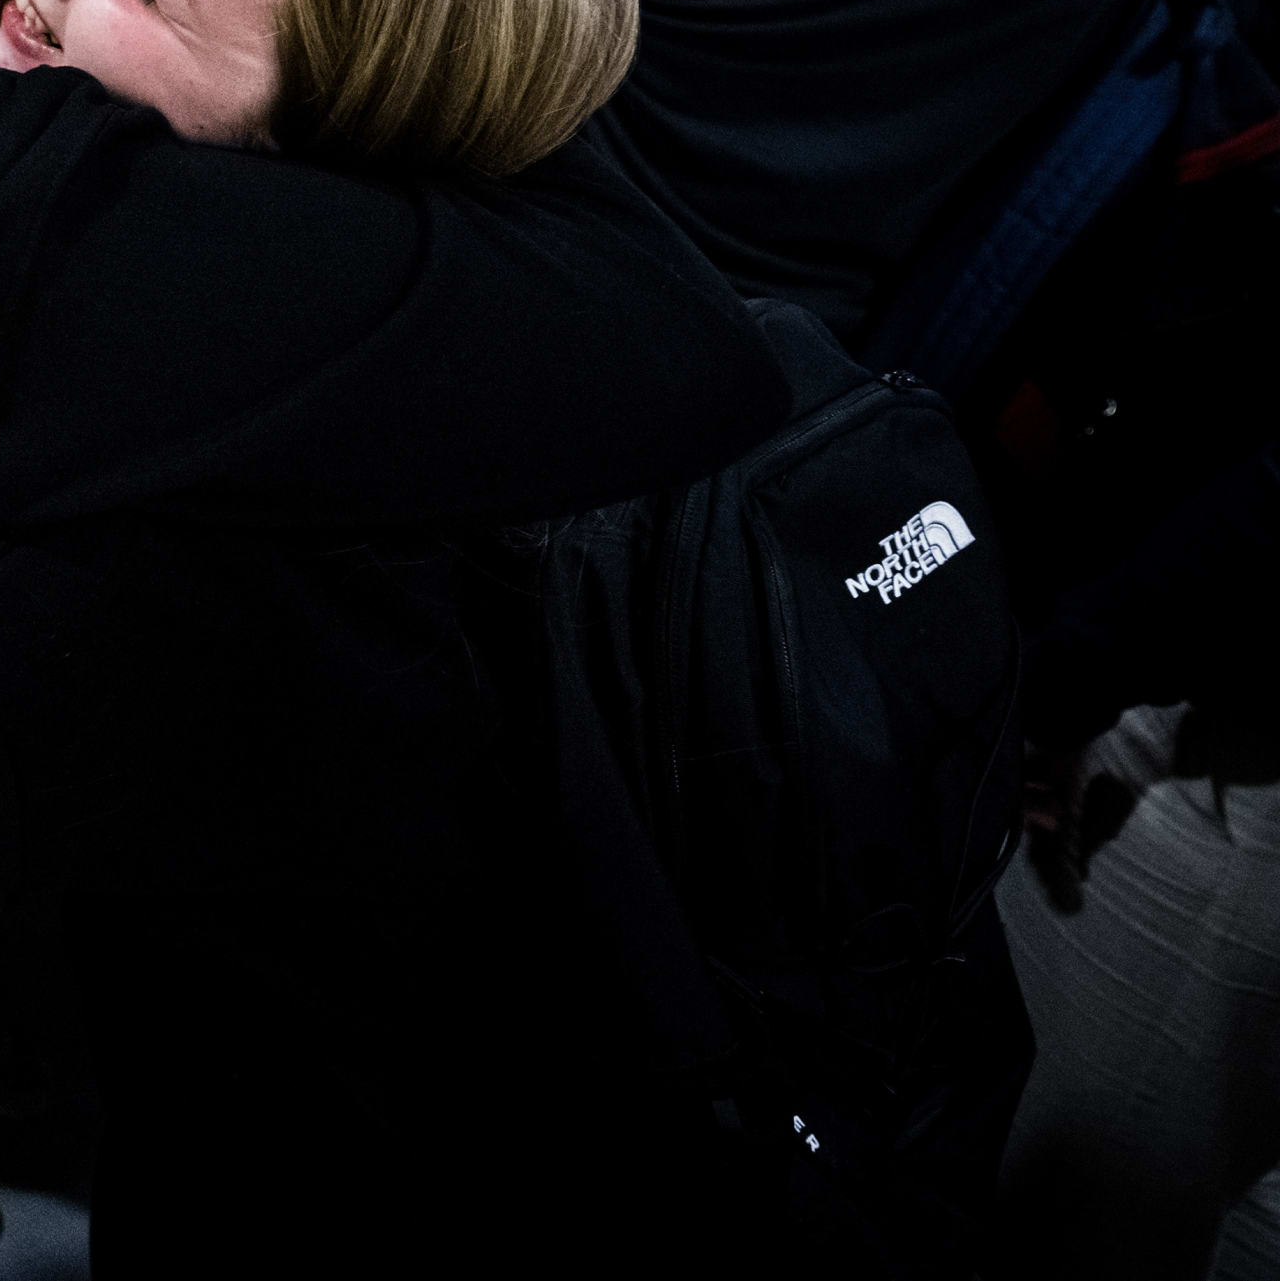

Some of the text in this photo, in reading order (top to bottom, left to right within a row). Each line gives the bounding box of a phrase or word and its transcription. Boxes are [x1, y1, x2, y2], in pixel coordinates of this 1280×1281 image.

[879, 513, 924, 556] THE
[845, 531, 930, 599] NORTH
[877, 549, 938, 605] FACE
